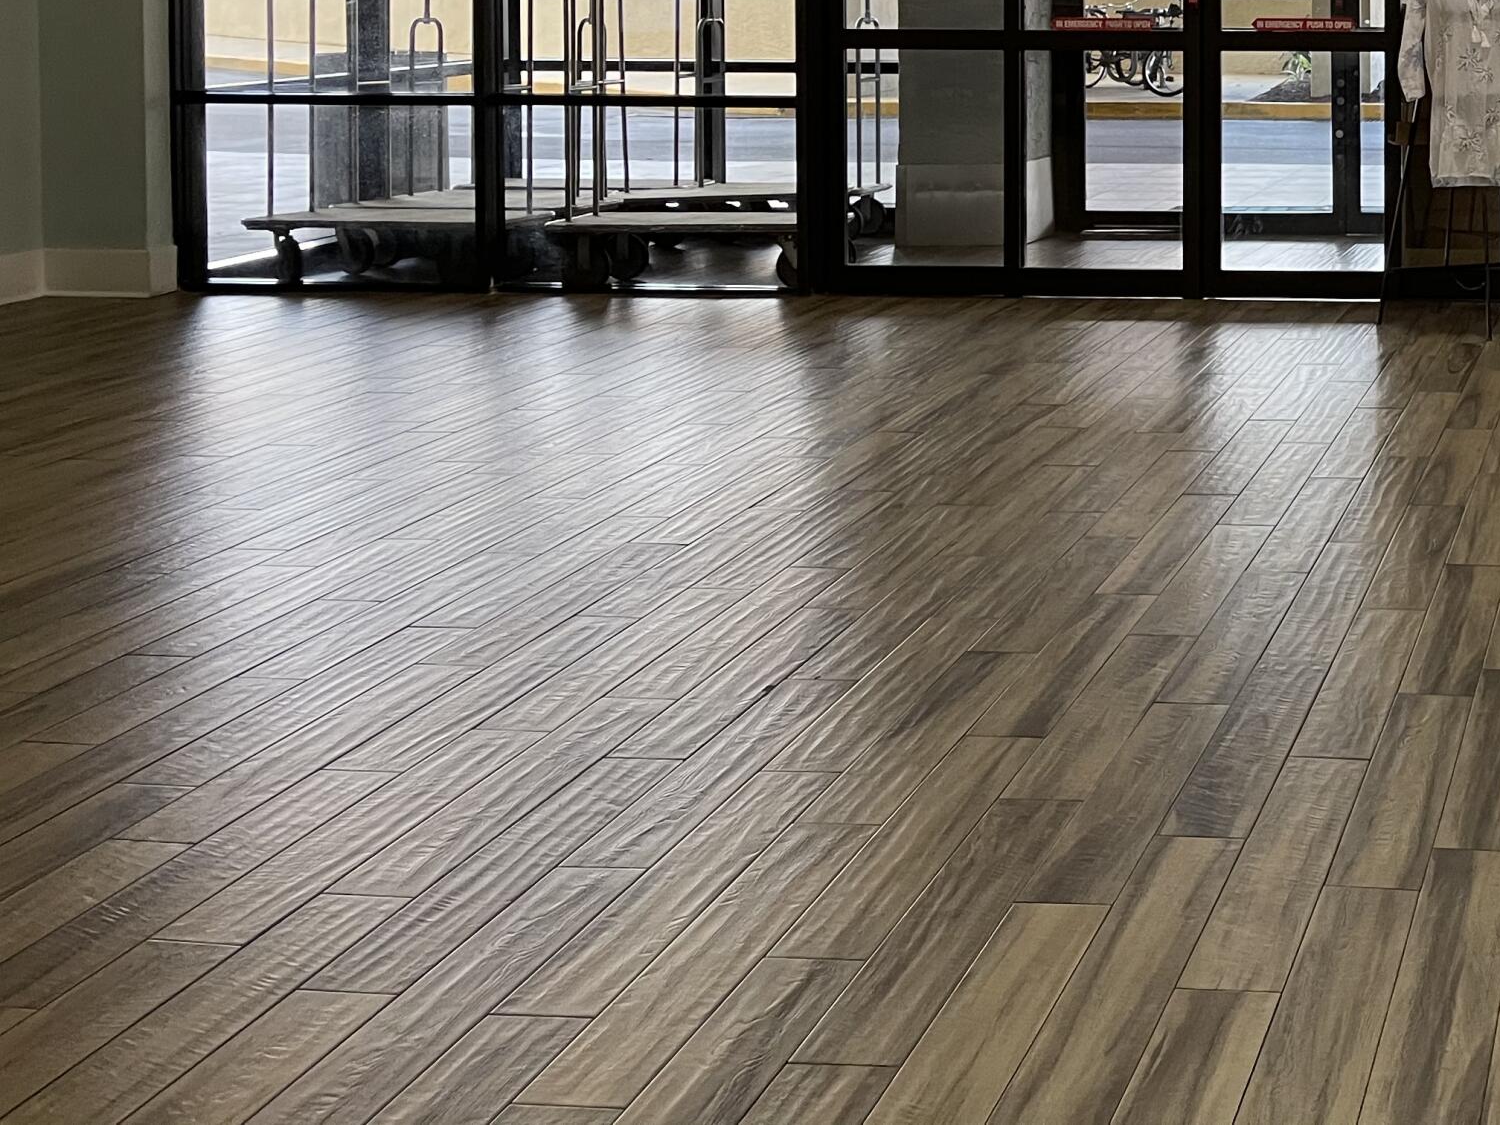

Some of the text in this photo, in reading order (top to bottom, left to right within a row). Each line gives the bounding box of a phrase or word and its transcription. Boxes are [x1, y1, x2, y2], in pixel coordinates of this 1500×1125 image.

[1055, 20, 1151, 28] IN EMERGENCY PUSH TO OPEN
[1256, 20, 1352, 28] IN EMERGENCY PUSH TO OPEN
